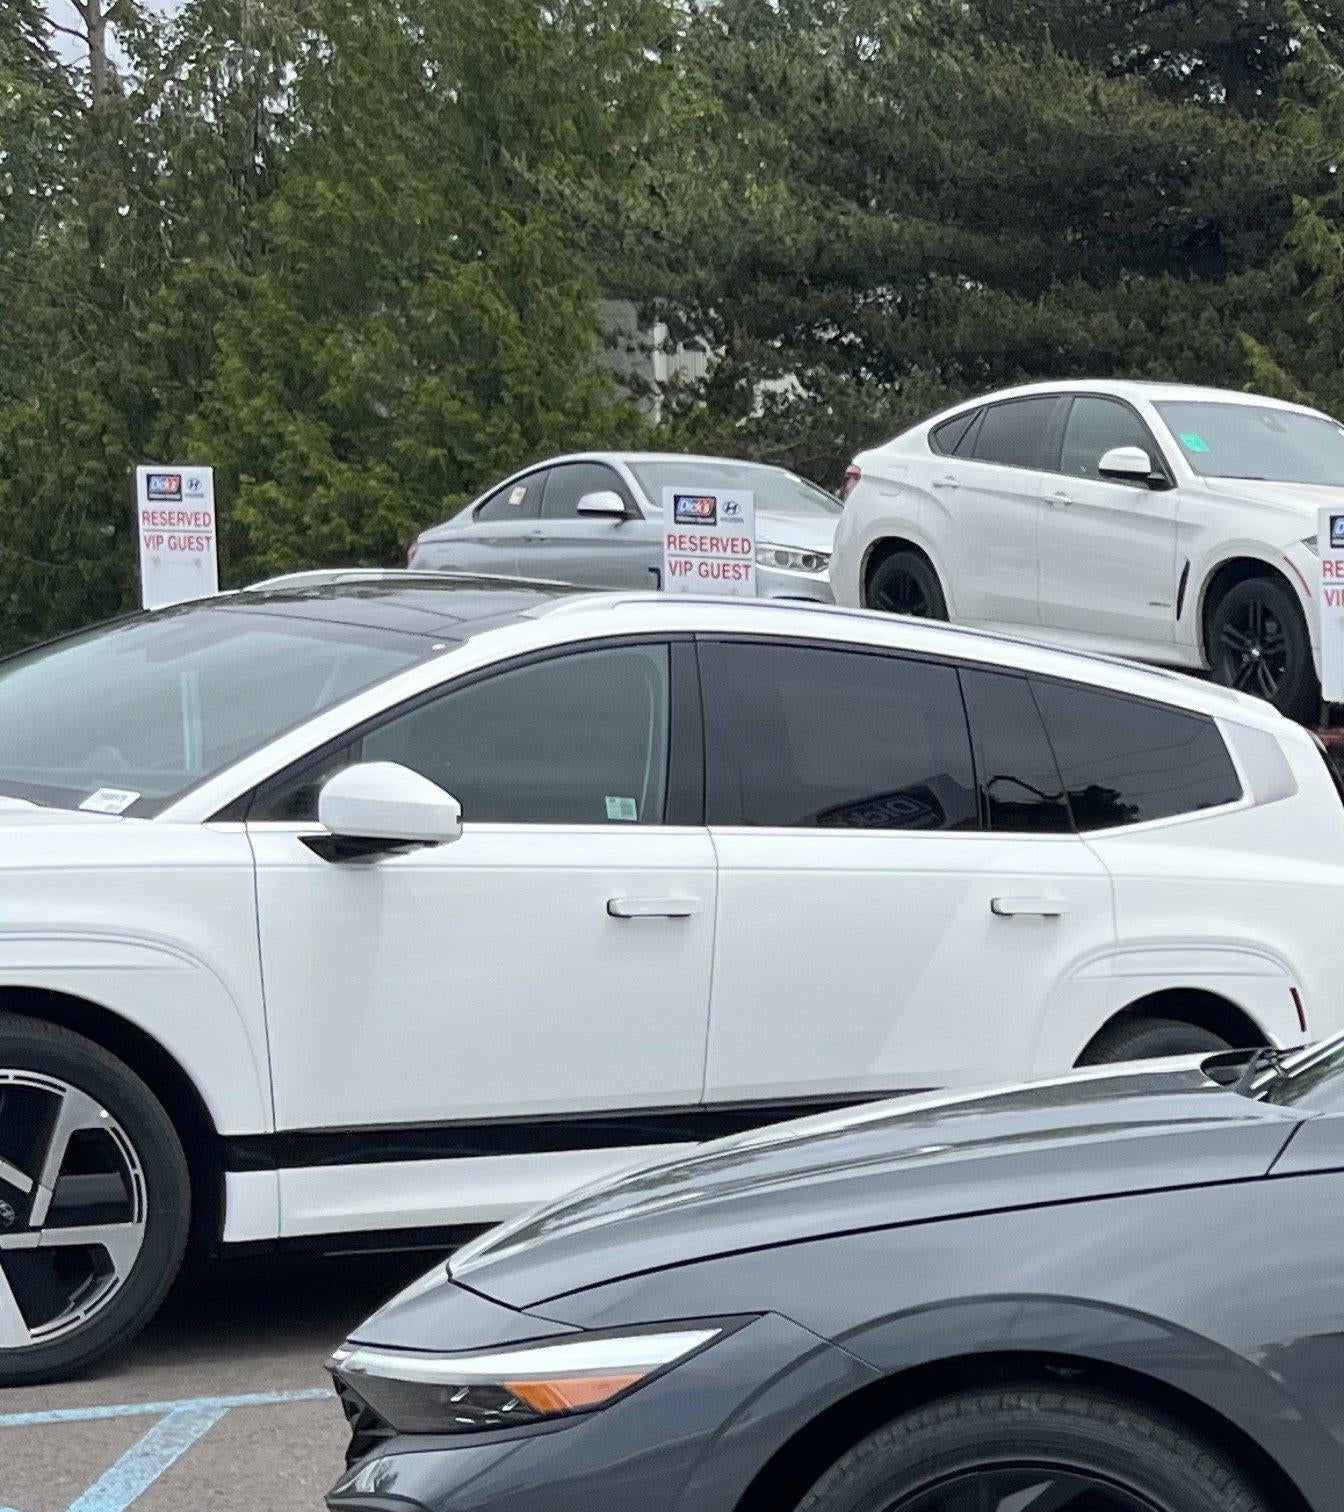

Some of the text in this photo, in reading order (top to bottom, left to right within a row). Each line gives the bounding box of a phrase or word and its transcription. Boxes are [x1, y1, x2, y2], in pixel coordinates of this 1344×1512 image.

[142, 510, 212, 528] RESERVED
[143, 534, 213, 552] VIP GUEST
[666, 533, 752, 555] RESERVED
[668, 559, 752, 581] VIP GUEST
